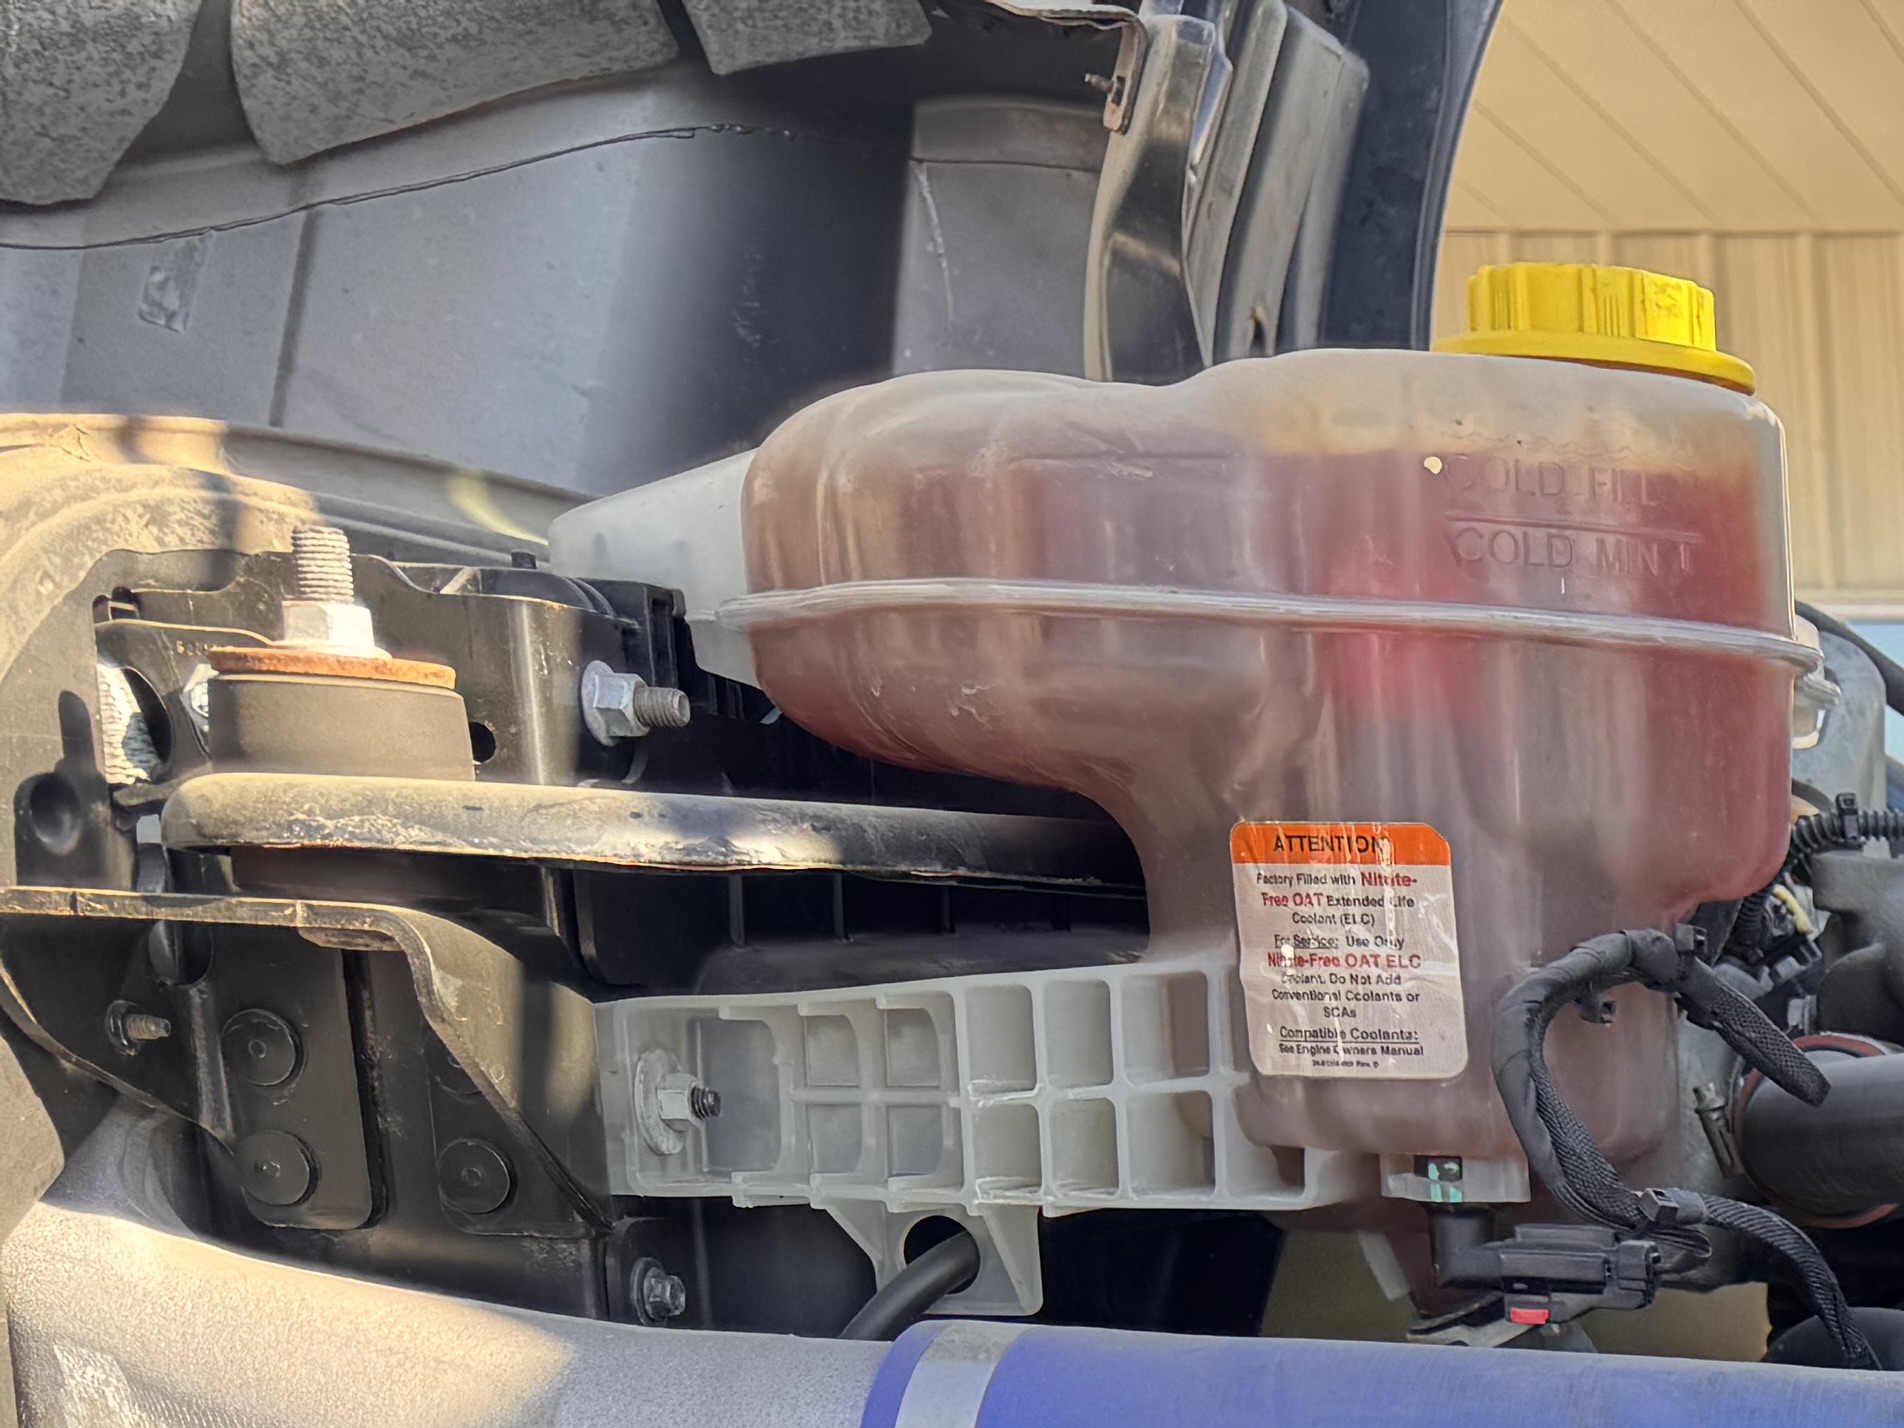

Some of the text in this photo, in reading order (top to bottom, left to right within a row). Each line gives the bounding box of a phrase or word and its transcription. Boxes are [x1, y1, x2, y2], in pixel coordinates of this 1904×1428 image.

[1454, 526, 1574, 569] COLD
[1256, 872, 1295, 888] Factory
[1296, 872, 1328, 886] Filled
[1330, 873, 1357, 886] with
[1261, 892, 1289, 907] Free
[1293, 893, 1324, 907] OAT
[1326, 894, 1385, 908] Extended
[1291, 912, 1376, 927] Coolant (ELC)
[1346, 935, 1370, 948] Use
[1344, 953, 1381, 969] OAT
[1385, 954, 1422, 969] ELC
[1329, 973, 1347, 985] Do
[1349, 973, 1372, 985] Not
[1375, 974, 1402, 986] Add
[1345, 990, 1403, 1002] Coolants
[1405, 992, 1421, 1002] or
[1322, 1006, 1357, 1018] SCAs
[1350, 1027, 1419, 1042] Coolants:
[1296, 1044, 1333, 1056] Engine
[1380, 1045, 1424, 1056] Manual
